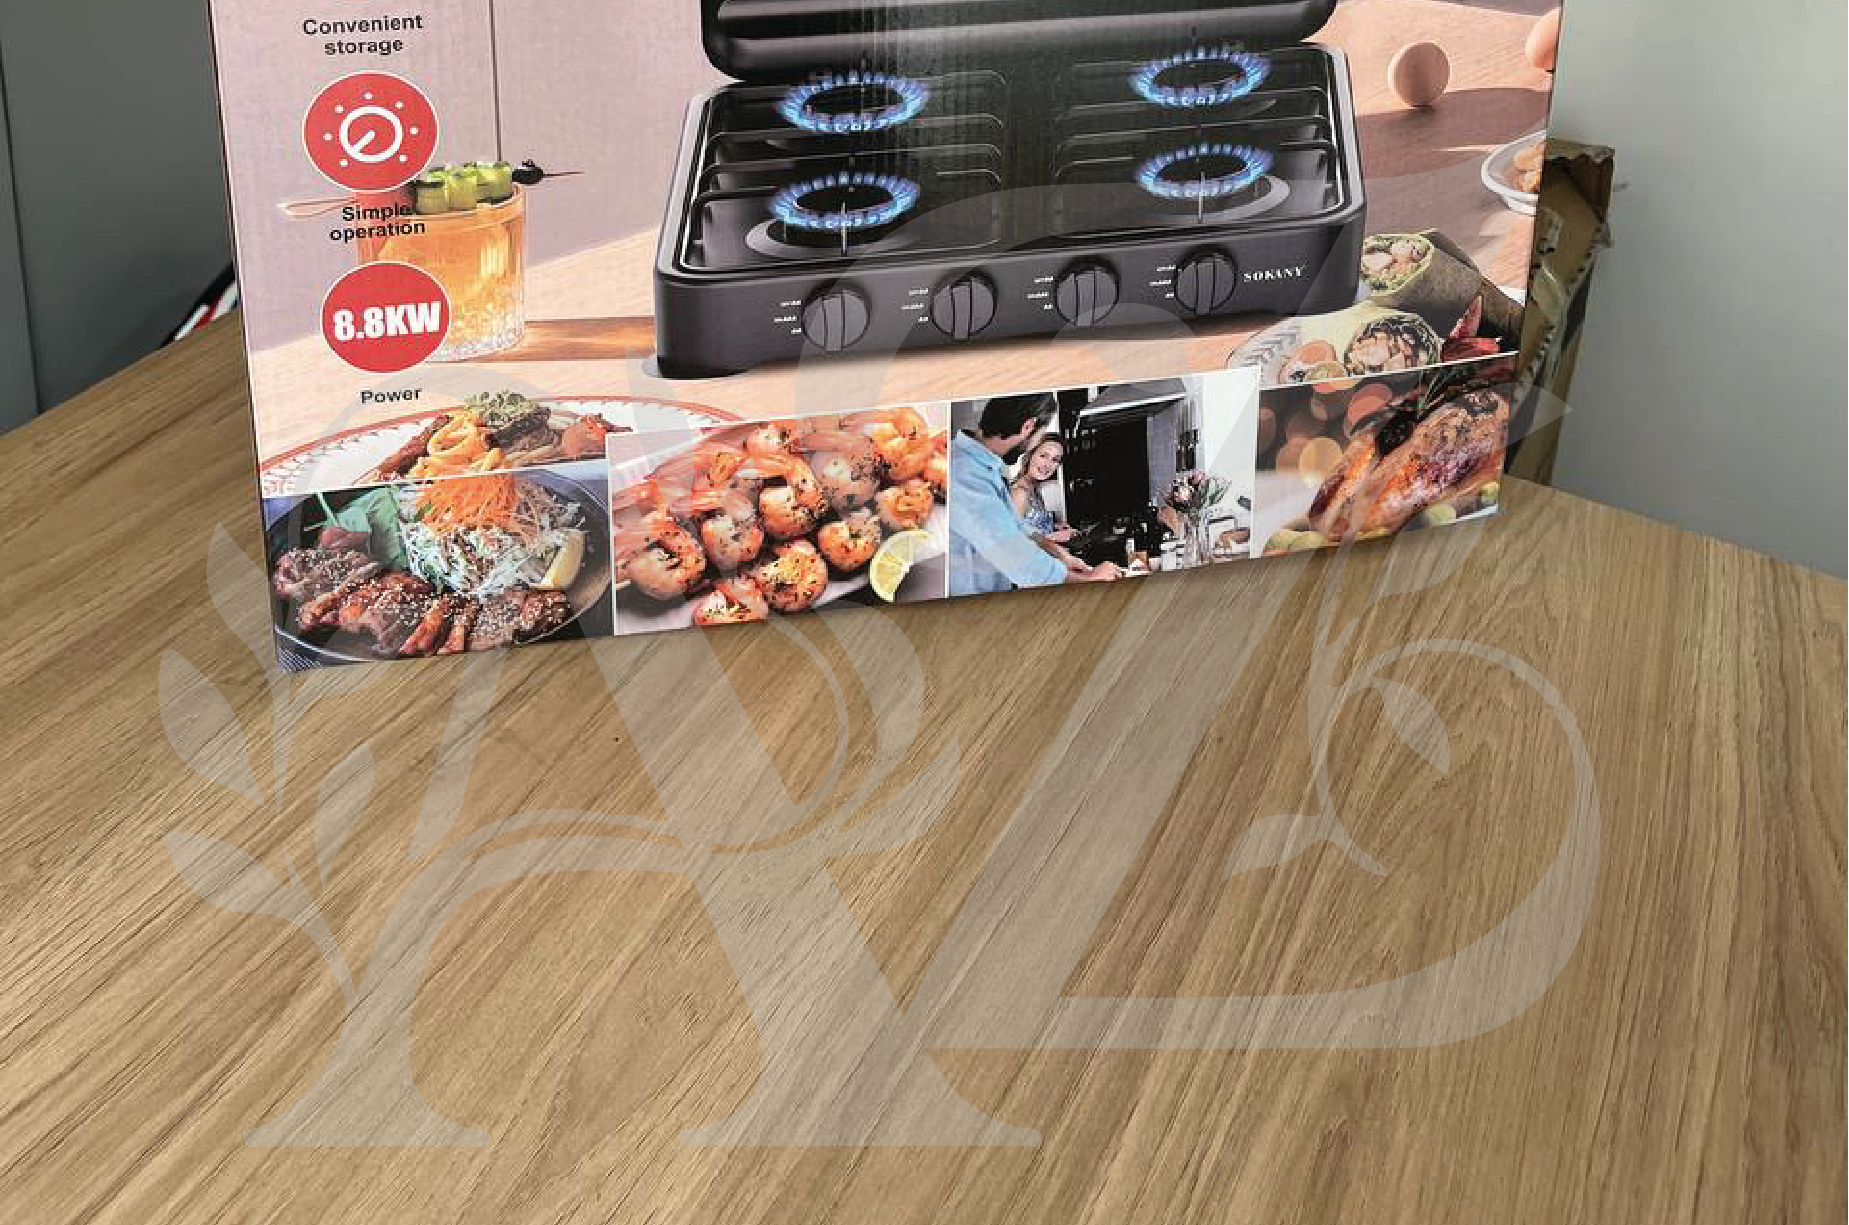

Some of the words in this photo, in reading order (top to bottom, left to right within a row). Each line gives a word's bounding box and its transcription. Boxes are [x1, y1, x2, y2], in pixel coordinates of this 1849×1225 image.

[303, 14, 423, 35] Convenient
[324, 38, 404, 56] storage
[342, 202, 412, 224] Simple
[330, 221, 425, 243] operation
[333, 301, 441, 342] 8.8KW
[361, 388, 422, 404] Power
